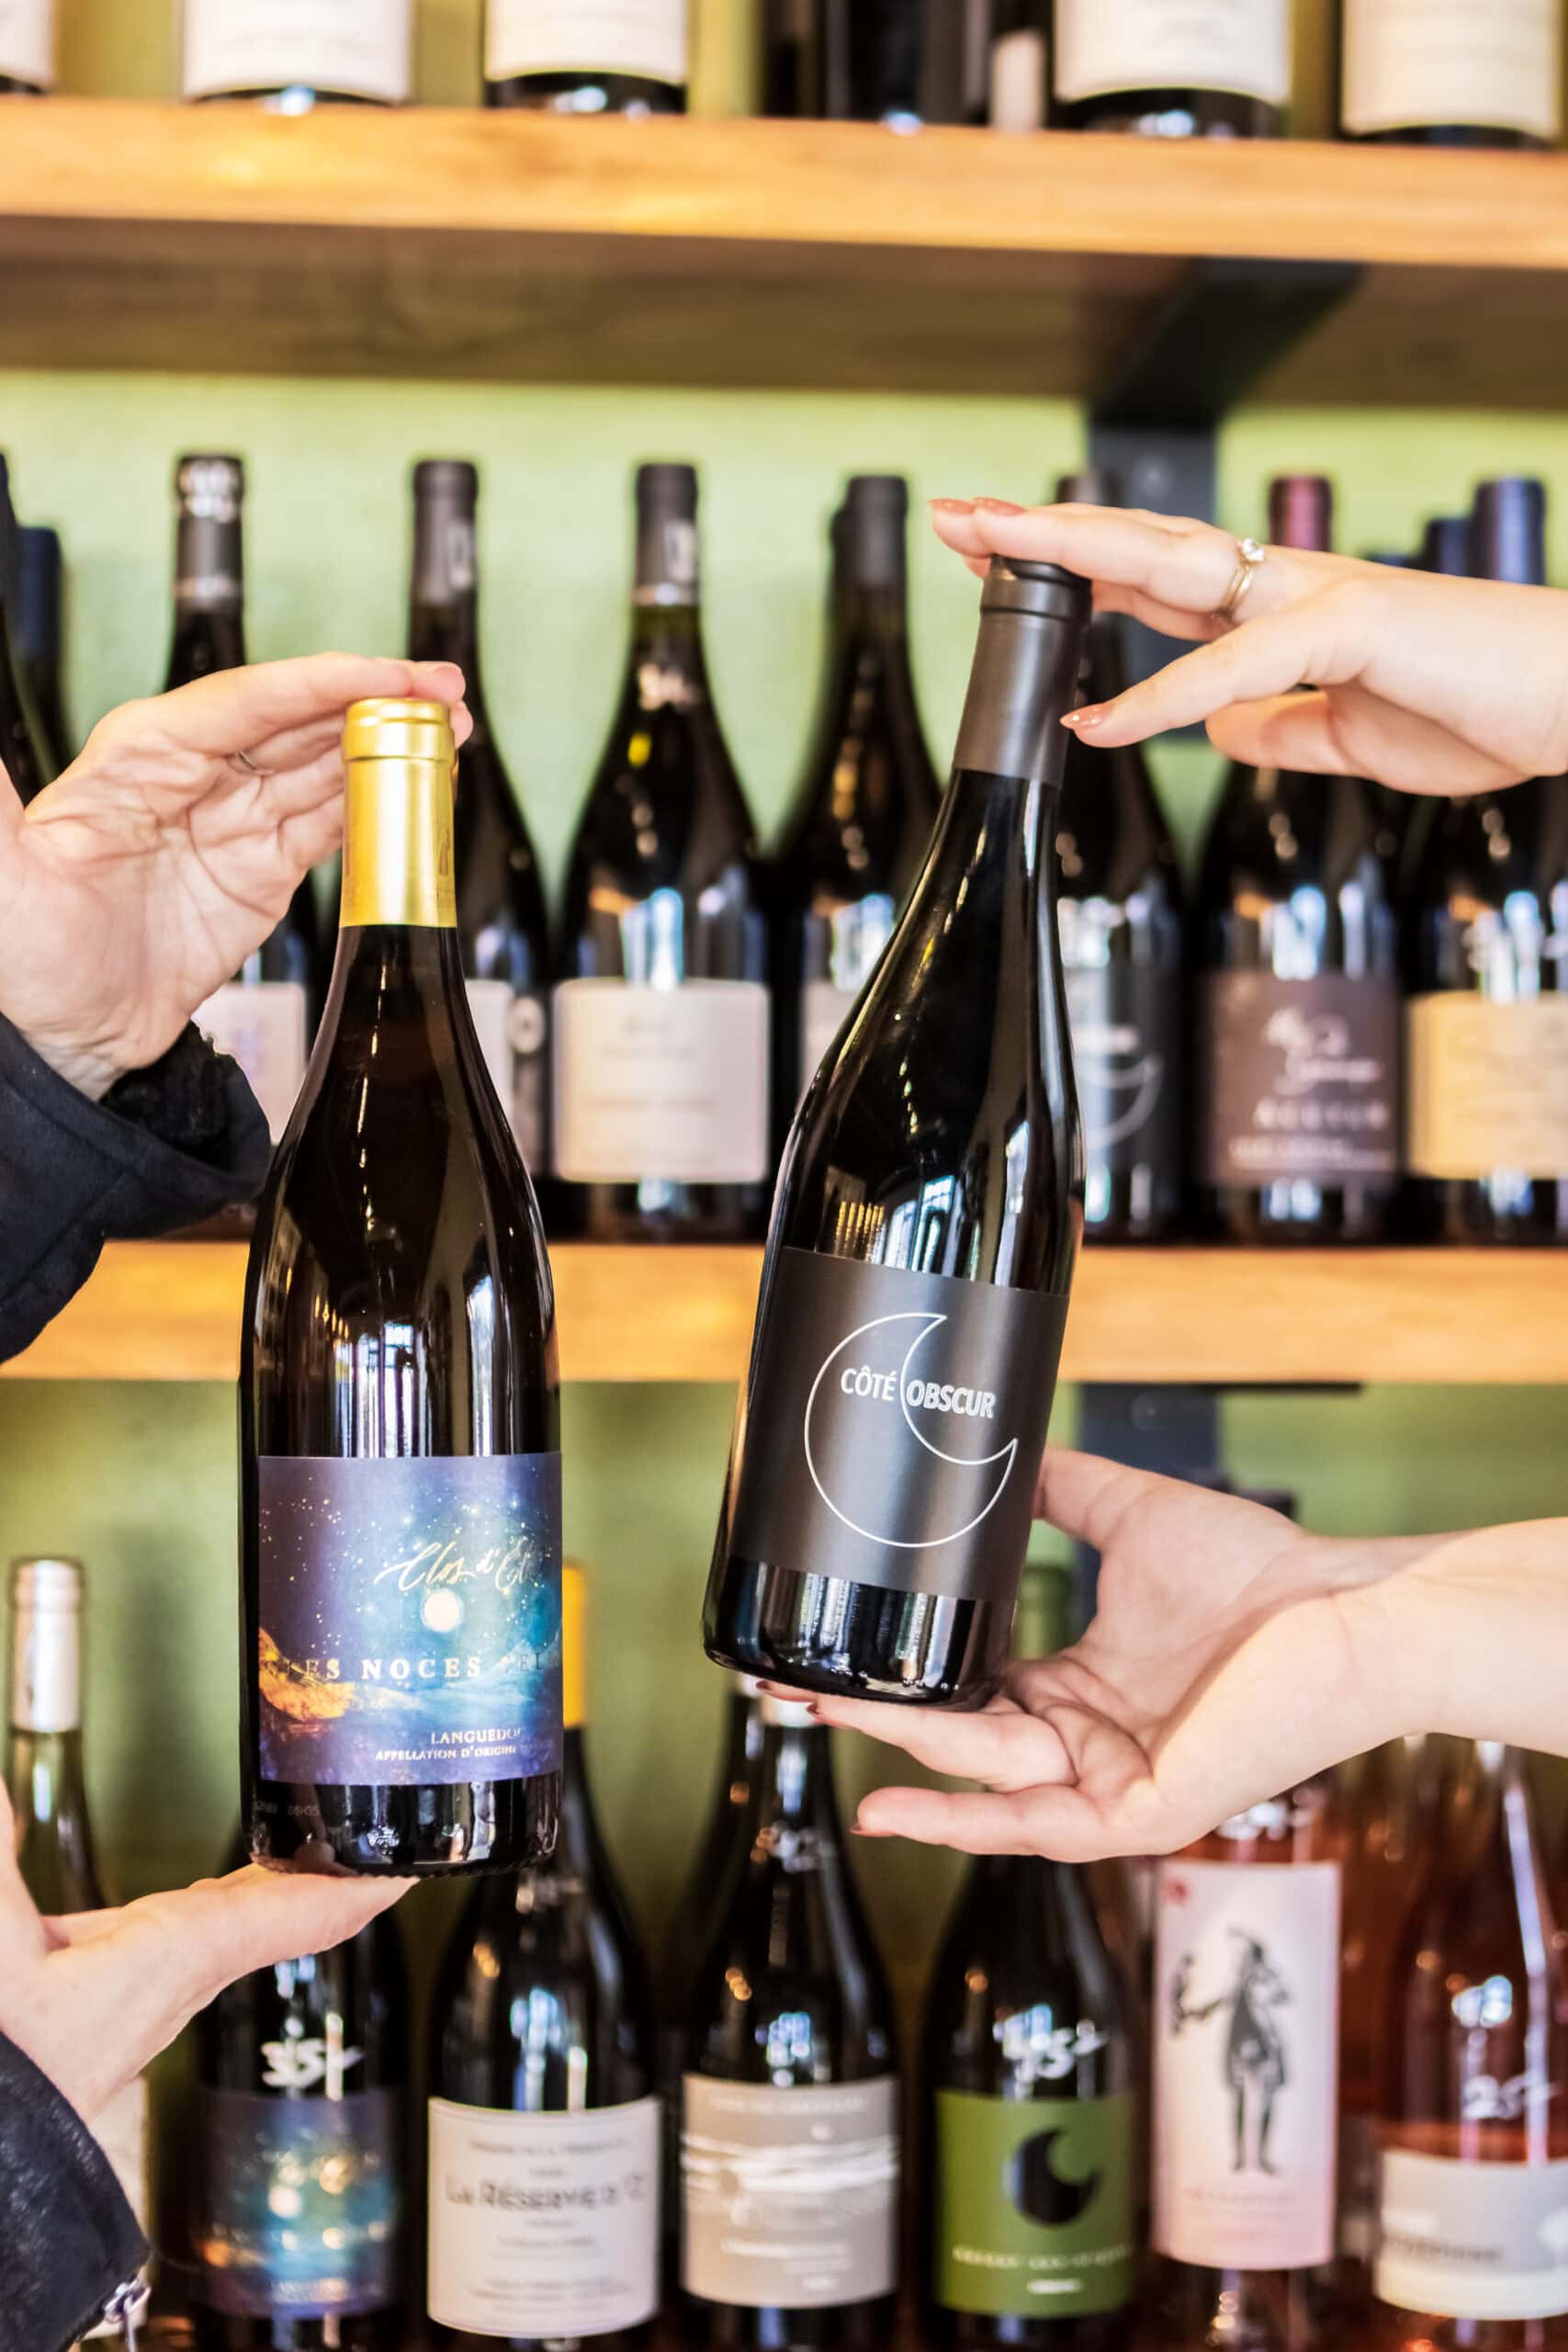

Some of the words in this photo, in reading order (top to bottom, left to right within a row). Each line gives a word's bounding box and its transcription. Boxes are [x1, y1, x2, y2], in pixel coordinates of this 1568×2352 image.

[840, 1365, 897, 1401] CÔTÉ
[907, 1380, 996, 1418] OBSCUR
[361, 1657, 480, 1679] NOCES
[375, 1749, 457, 1761] APPELLATION
